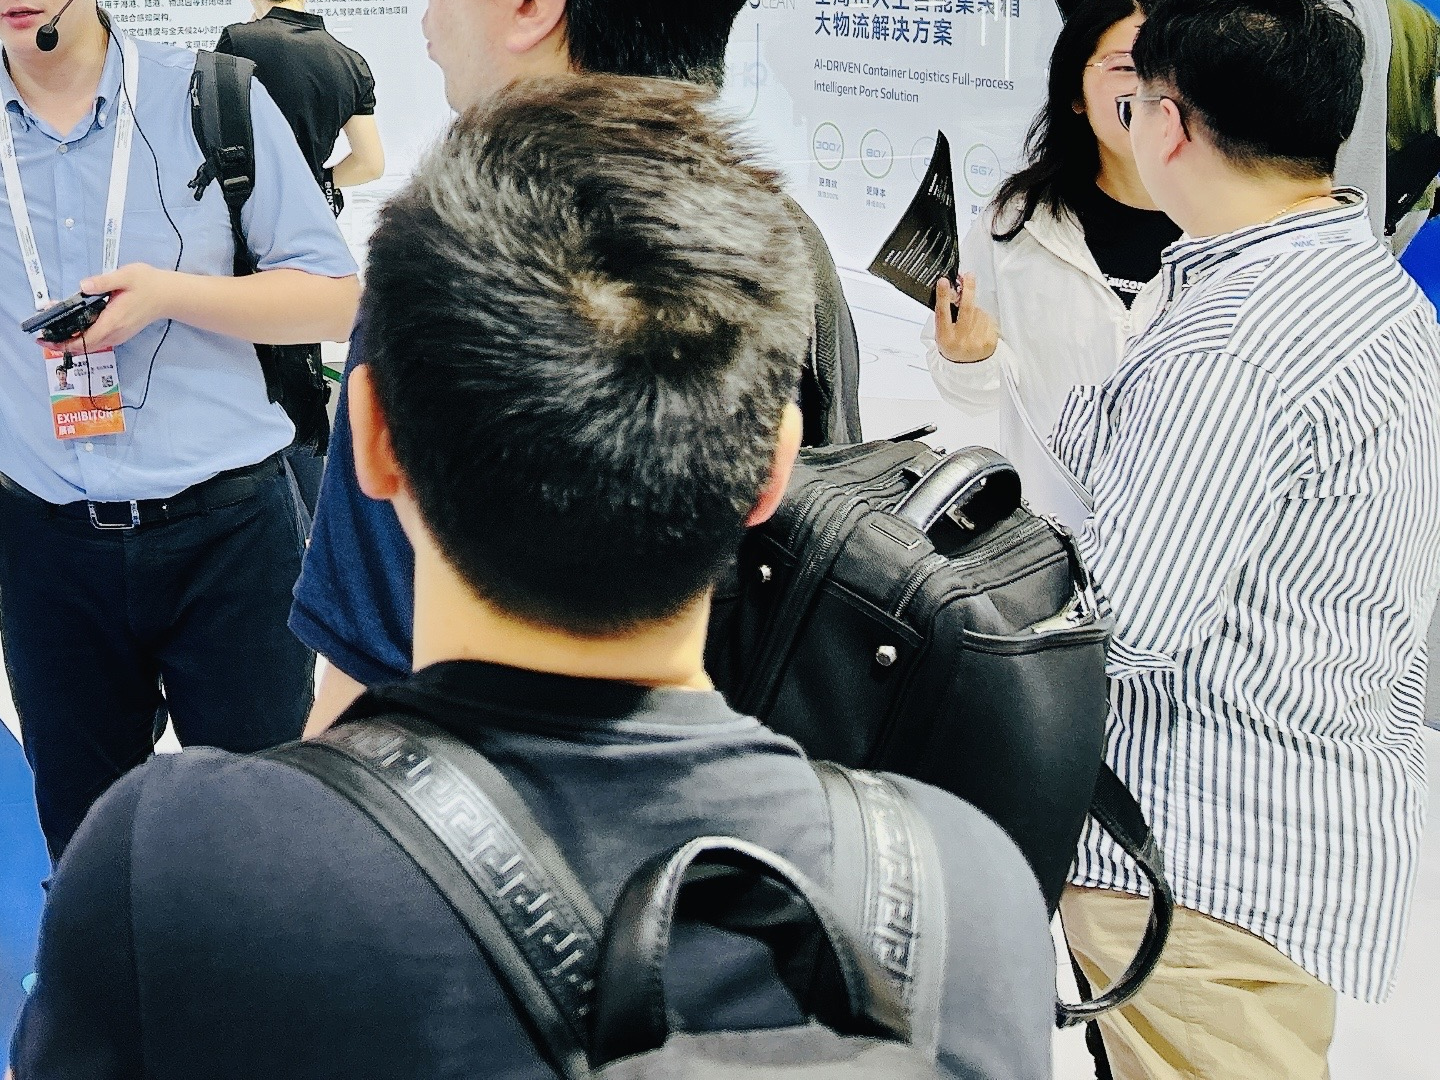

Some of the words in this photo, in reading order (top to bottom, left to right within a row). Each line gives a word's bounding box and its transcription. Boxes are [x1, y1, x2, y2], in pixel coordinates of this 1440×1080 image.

[814, 10, 953, 47] 大物流解决方案
[813, 58, 861, 75] AI-DRIVEN
[862, 63, 907, 80] Container
[907, 68, 950, 86] Logistics
[951, 72, 1014, 91] Full-process
[813, 80, 858, 98] Intelligent
[858, 83, 879, 98] Port
[879, 86, 919, 103] Solution
[56, 407, 114, 425] EXHIBITOR
